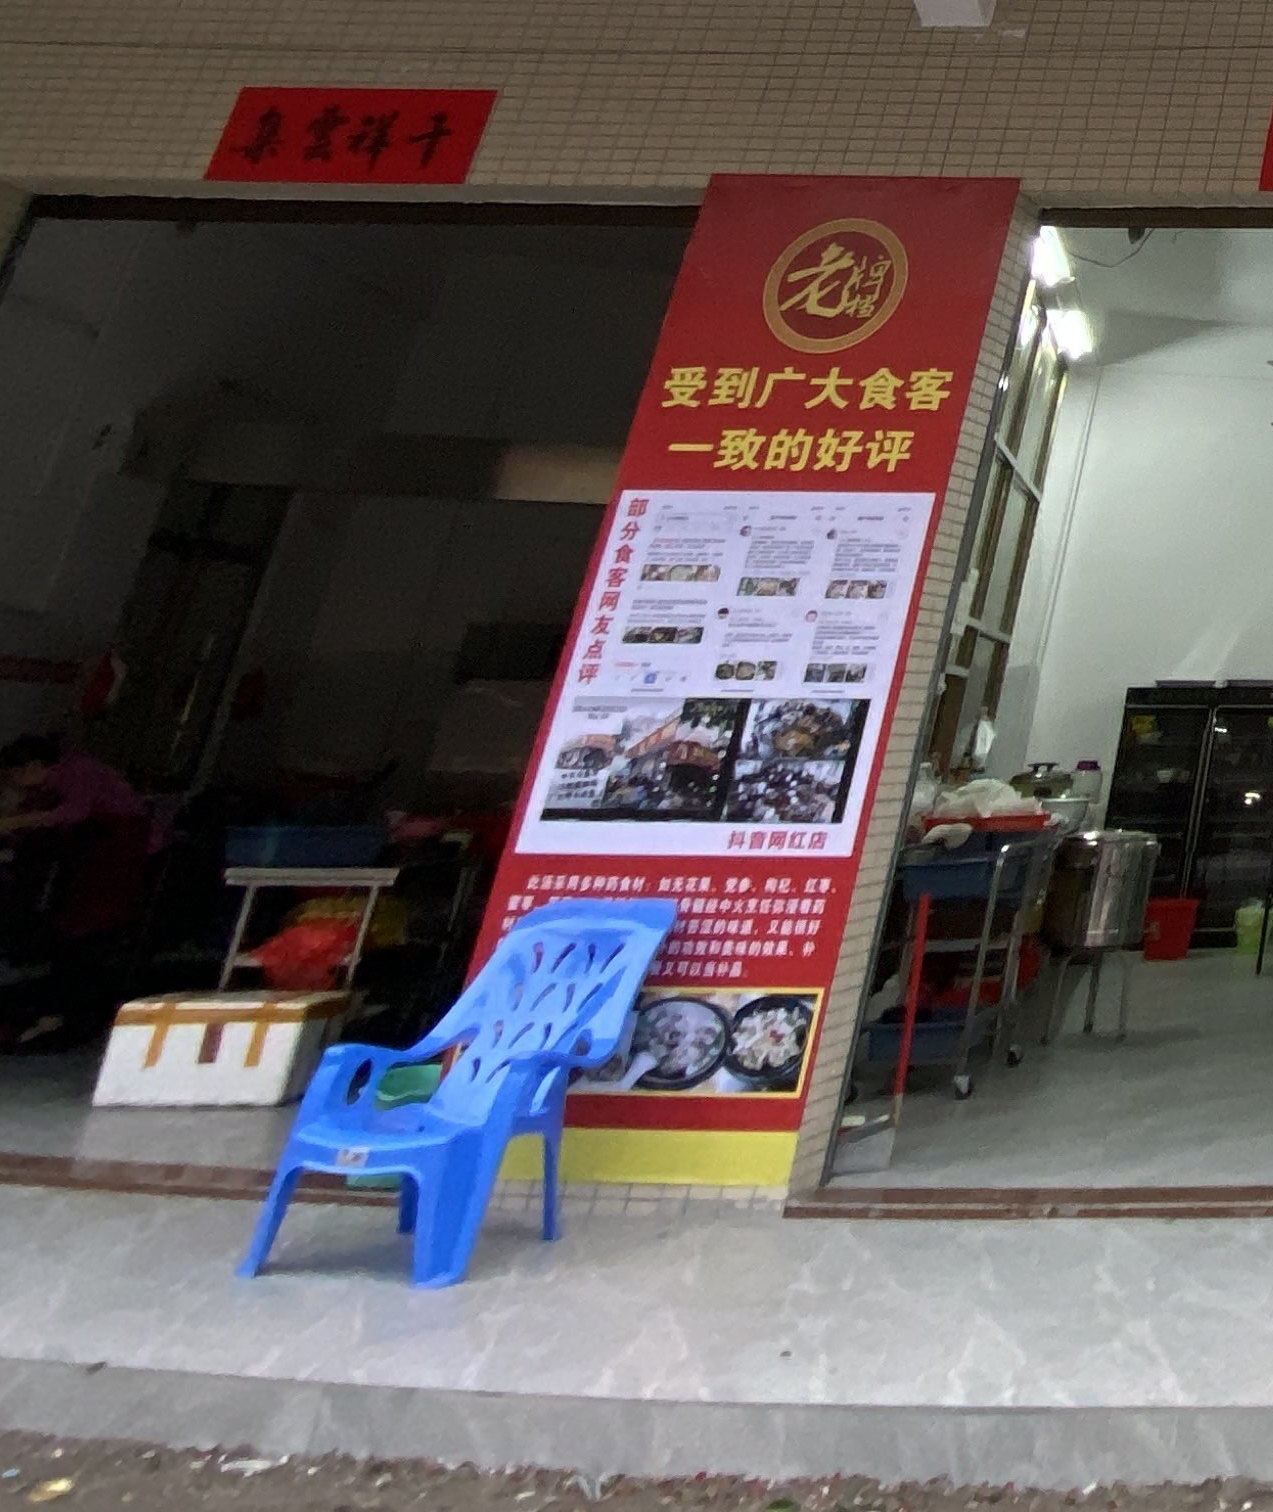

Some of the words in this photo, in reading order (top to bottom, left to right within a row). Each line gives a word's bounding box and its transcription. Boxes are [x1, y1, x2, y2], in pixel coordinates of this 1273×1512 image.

[661, 365, 954, 411] 受到广大食客
[668, 428, 915, 473] 一致的好评
[576, 497, 650, 686] 部分食客网友点评
[727, 830, 829, 851] 抖音网红店
